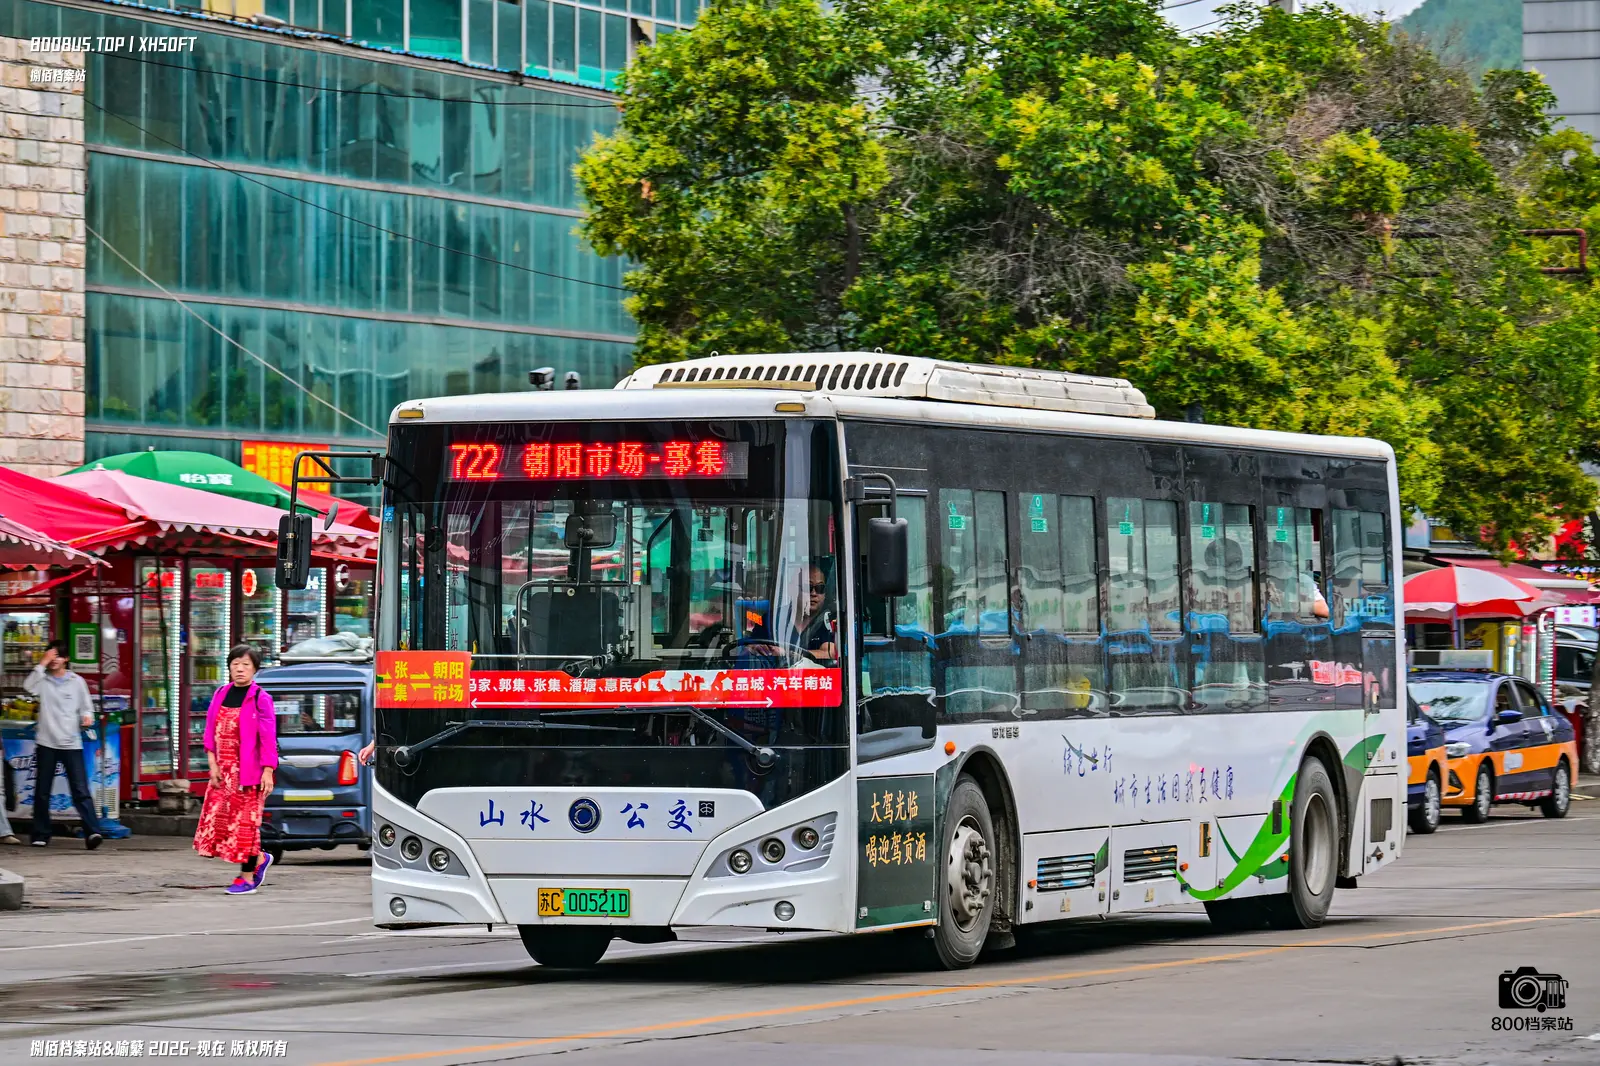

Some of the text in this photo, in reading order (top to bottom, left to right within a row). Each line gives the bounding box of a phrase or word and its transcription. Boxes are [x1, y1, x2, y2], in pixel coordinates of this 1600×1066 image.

[451, 441, 724, 478] 722 朝阳市场-郭集
[433, 661, 465, 679] 朝阳
[433, 684, 464, 702] 市场
[870, 789, 919, 825] 大驾光临
[865, 831, 926, 868] 喝迎驾贡酒
